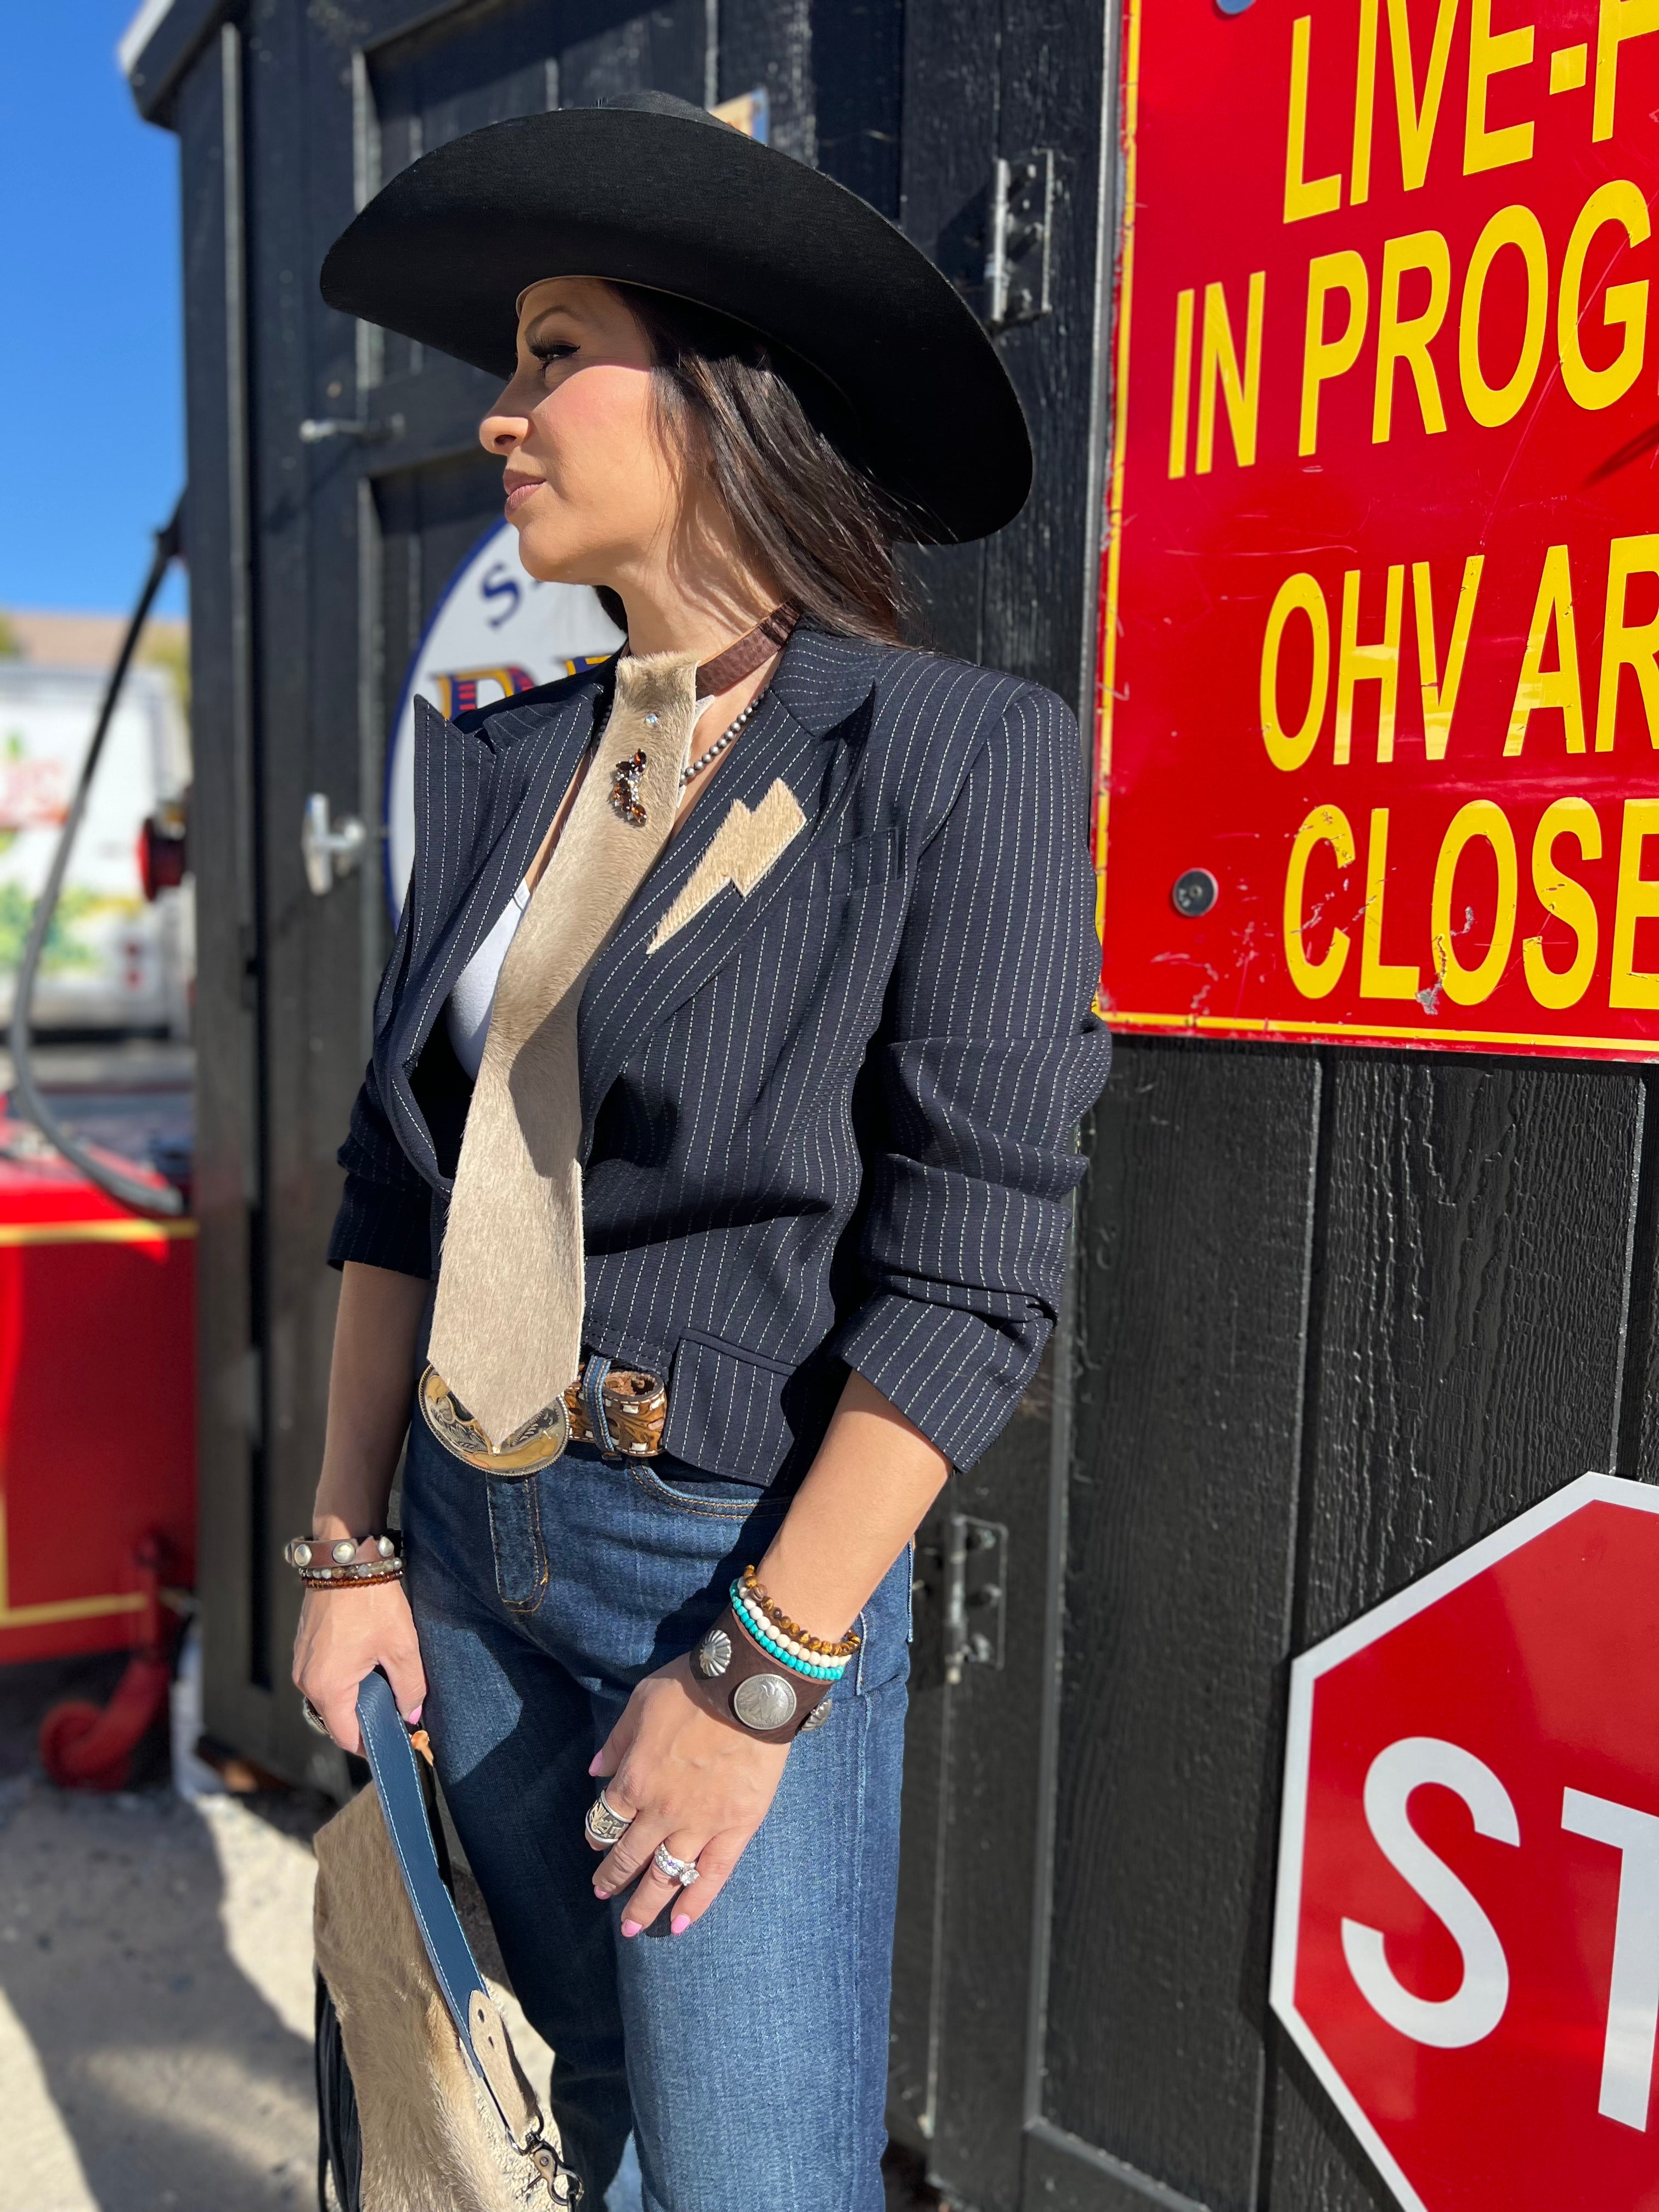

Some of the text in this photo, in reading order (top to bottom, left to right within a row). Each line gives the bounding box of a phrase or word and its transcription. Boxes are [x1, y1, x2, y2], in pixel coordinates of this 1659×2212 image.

[1169, 179, 1651, 481] IN PROG
[1260, 533, 1659, 771] OHV AR
[1284, 797, 1659, 1010] CLOSE
[1342, 1736, 1659, 2133] ST
